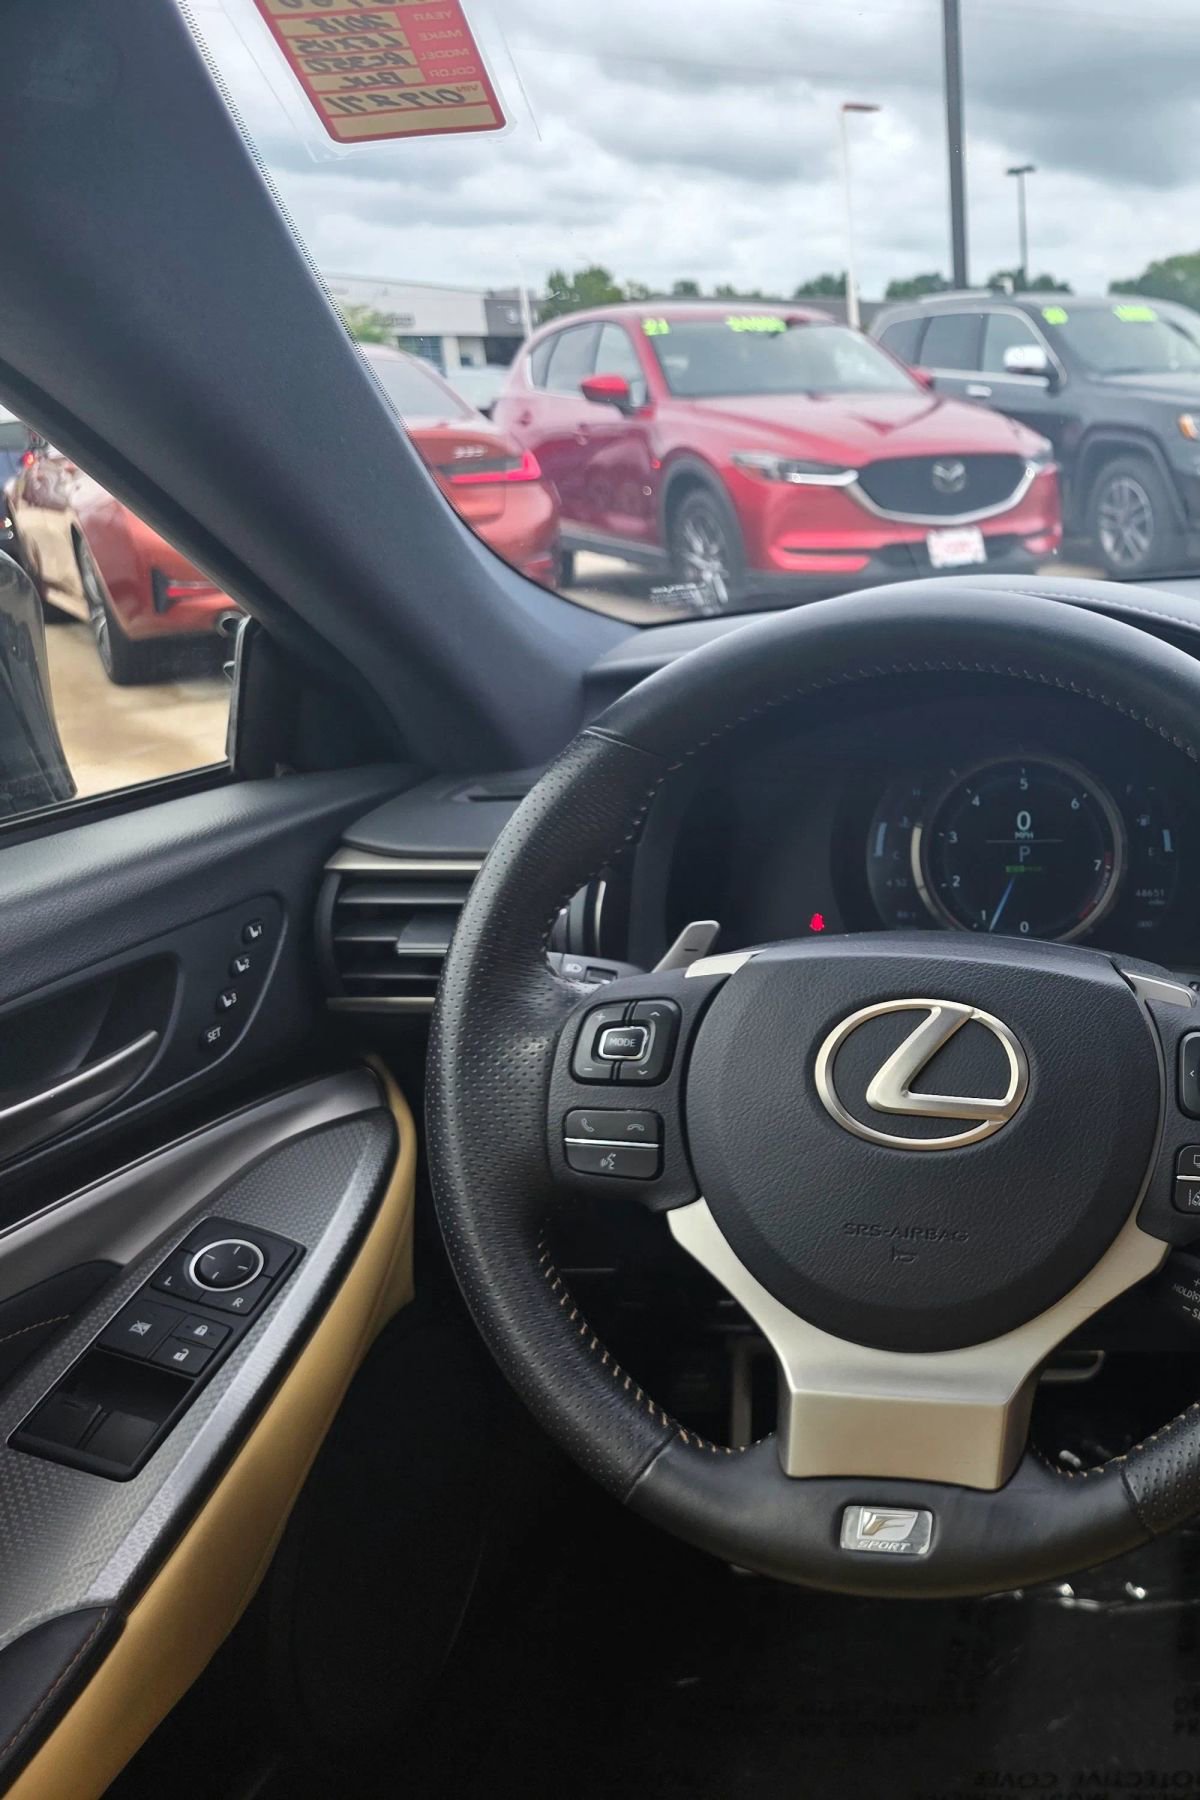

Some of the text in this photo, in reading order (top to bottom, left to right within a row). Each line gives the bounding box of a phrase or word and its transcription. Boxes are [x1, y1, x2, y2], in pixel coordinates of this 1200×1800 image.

[1020, 778, 1029, 790] 5
[971, 796, 980, 807] 4
[1071, 798, 1080, 810] 6
[1016, 810, 1032, 831] 0
[948, 832, 958, 844] 3
[1019, 846, 1031, 862] P
[1094, 860, 1102, 871] 7
[952, 875, 961, 888] 2
[980, 910, 986, 921] 1
[1019, 921, 1030, 933] 0
[207, 1026, 222, 1043] SET
[609, 1038, 637, 1048] MODE
[163, 1276, 173, 1286] L
[232, 1296, 244, 1308] R
[857, 1540, 911, 1551] SPORT
